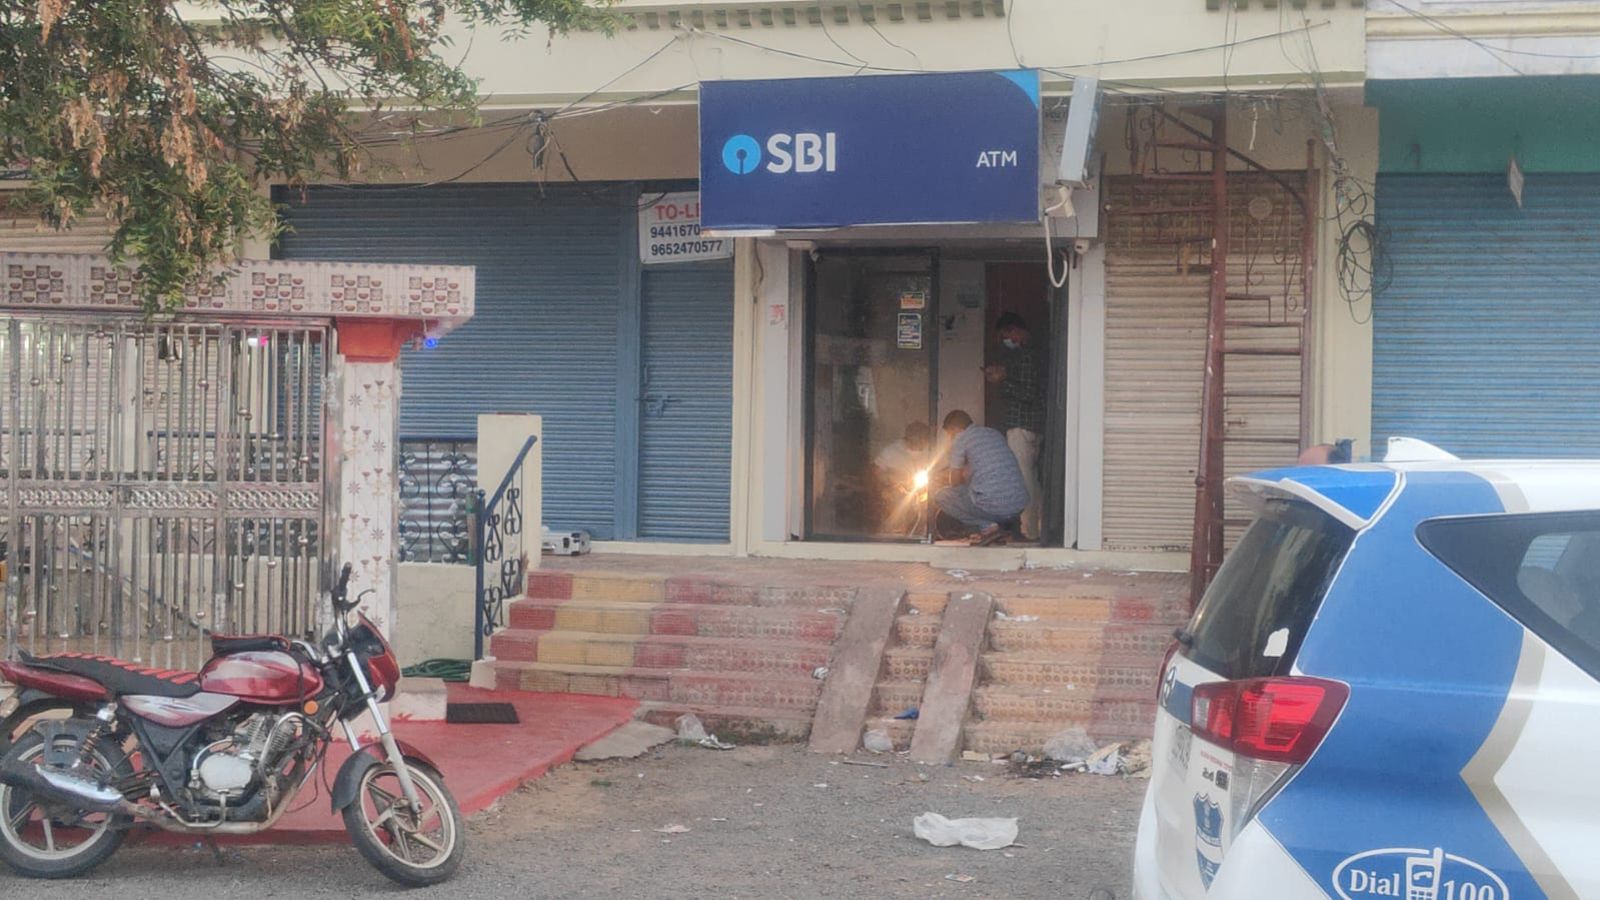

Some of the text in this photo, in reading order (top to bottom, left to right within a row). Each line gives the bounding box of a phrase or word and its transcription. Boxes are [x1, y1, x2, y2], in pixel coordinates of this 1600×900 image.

[767, 132, 836, 173] SBI
[976, 150, 1018, 168] ATM
[650, 224, 700, 238] 9441670
[651, 240, 722, 256] 9652470577
[1350, 869, 1495, 900] Dial 100
